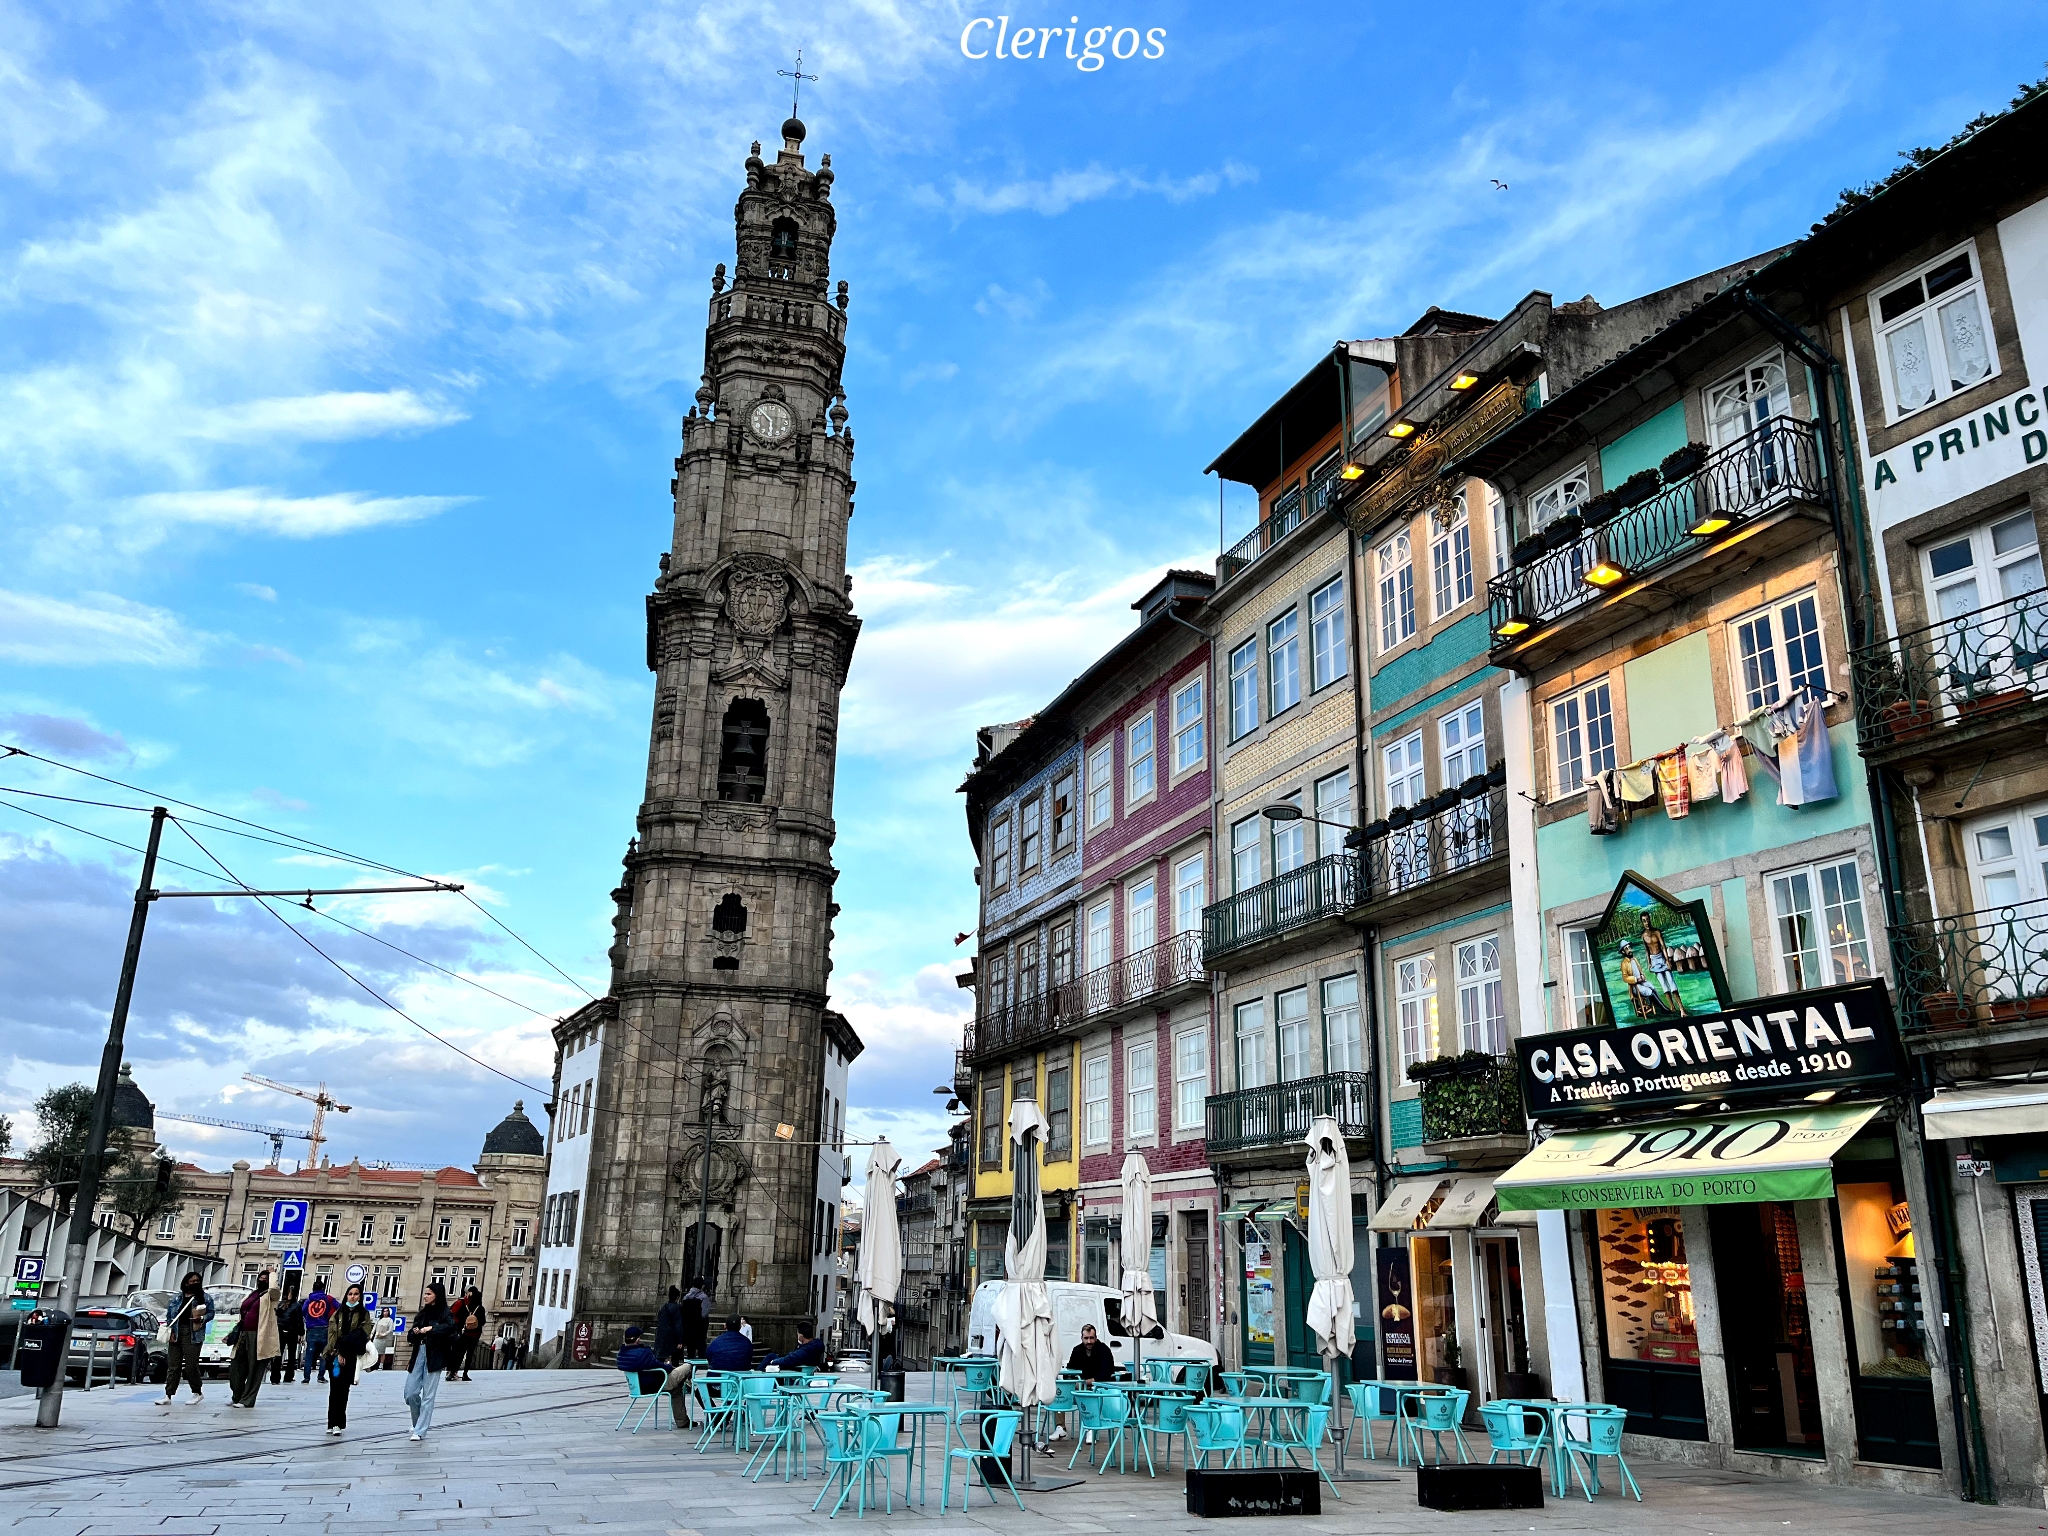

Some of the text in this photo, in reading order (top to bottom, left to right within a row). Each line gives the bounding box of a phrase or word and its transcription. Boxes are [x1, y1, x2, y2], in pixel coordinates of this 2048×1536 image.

[1480, 398, 1510, 425] BACALHAU
[1874, 459, 1897, 491] A
[1530, 1002, 1874, 1084] CASA ORIENTAL
[1550, 1050, 1852, 1103] A Tradição Portuguesa desde 1910
[1590, 1119, 1791, 1168] 1910
[1792, 1125, 1854, 1142] PORTO
[1571, 1185, 1665, 1202] CONSERVEIRA
[1672, 1183, 1694, 1197] DO
[1703, 1180, 1756, 1196] PORTO
[278, 1204, 300, 1231] P
[22, 1261, 38, 1278] P
